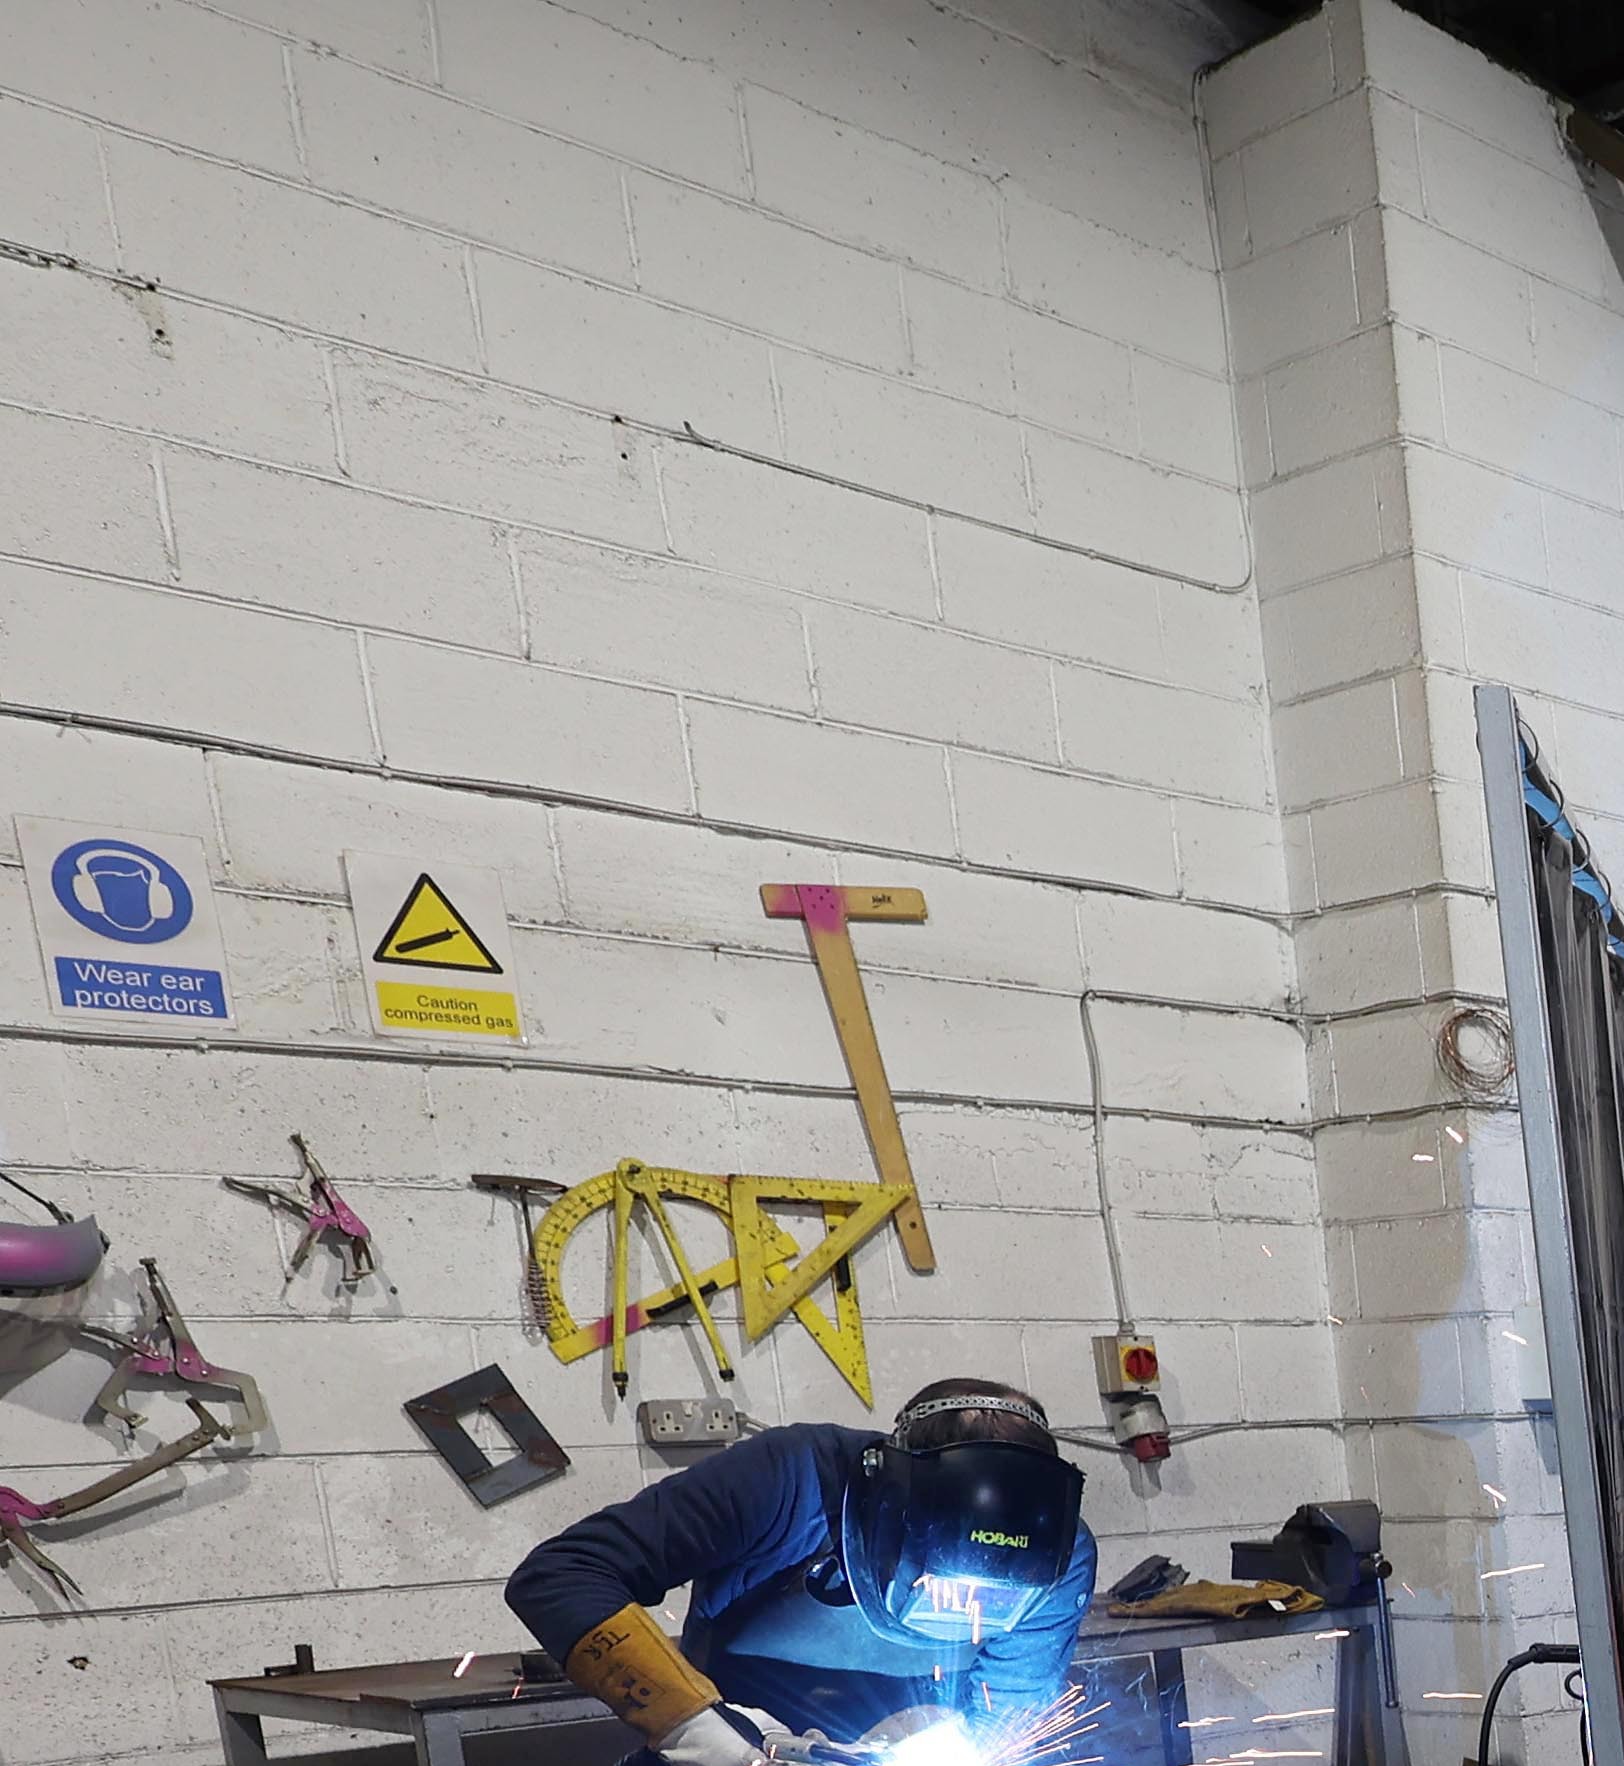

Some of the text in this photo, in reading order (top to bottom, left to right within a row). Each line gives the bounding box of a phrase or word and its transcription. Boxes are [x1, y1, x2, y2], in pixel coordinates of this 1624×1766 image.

[74, 961, 205, 992] Wear ear
[74, 989, 214, 1016] protectors
[416, 994, 478, 1011] Caution
[384, 1008, 514, 1029] compressed gas
